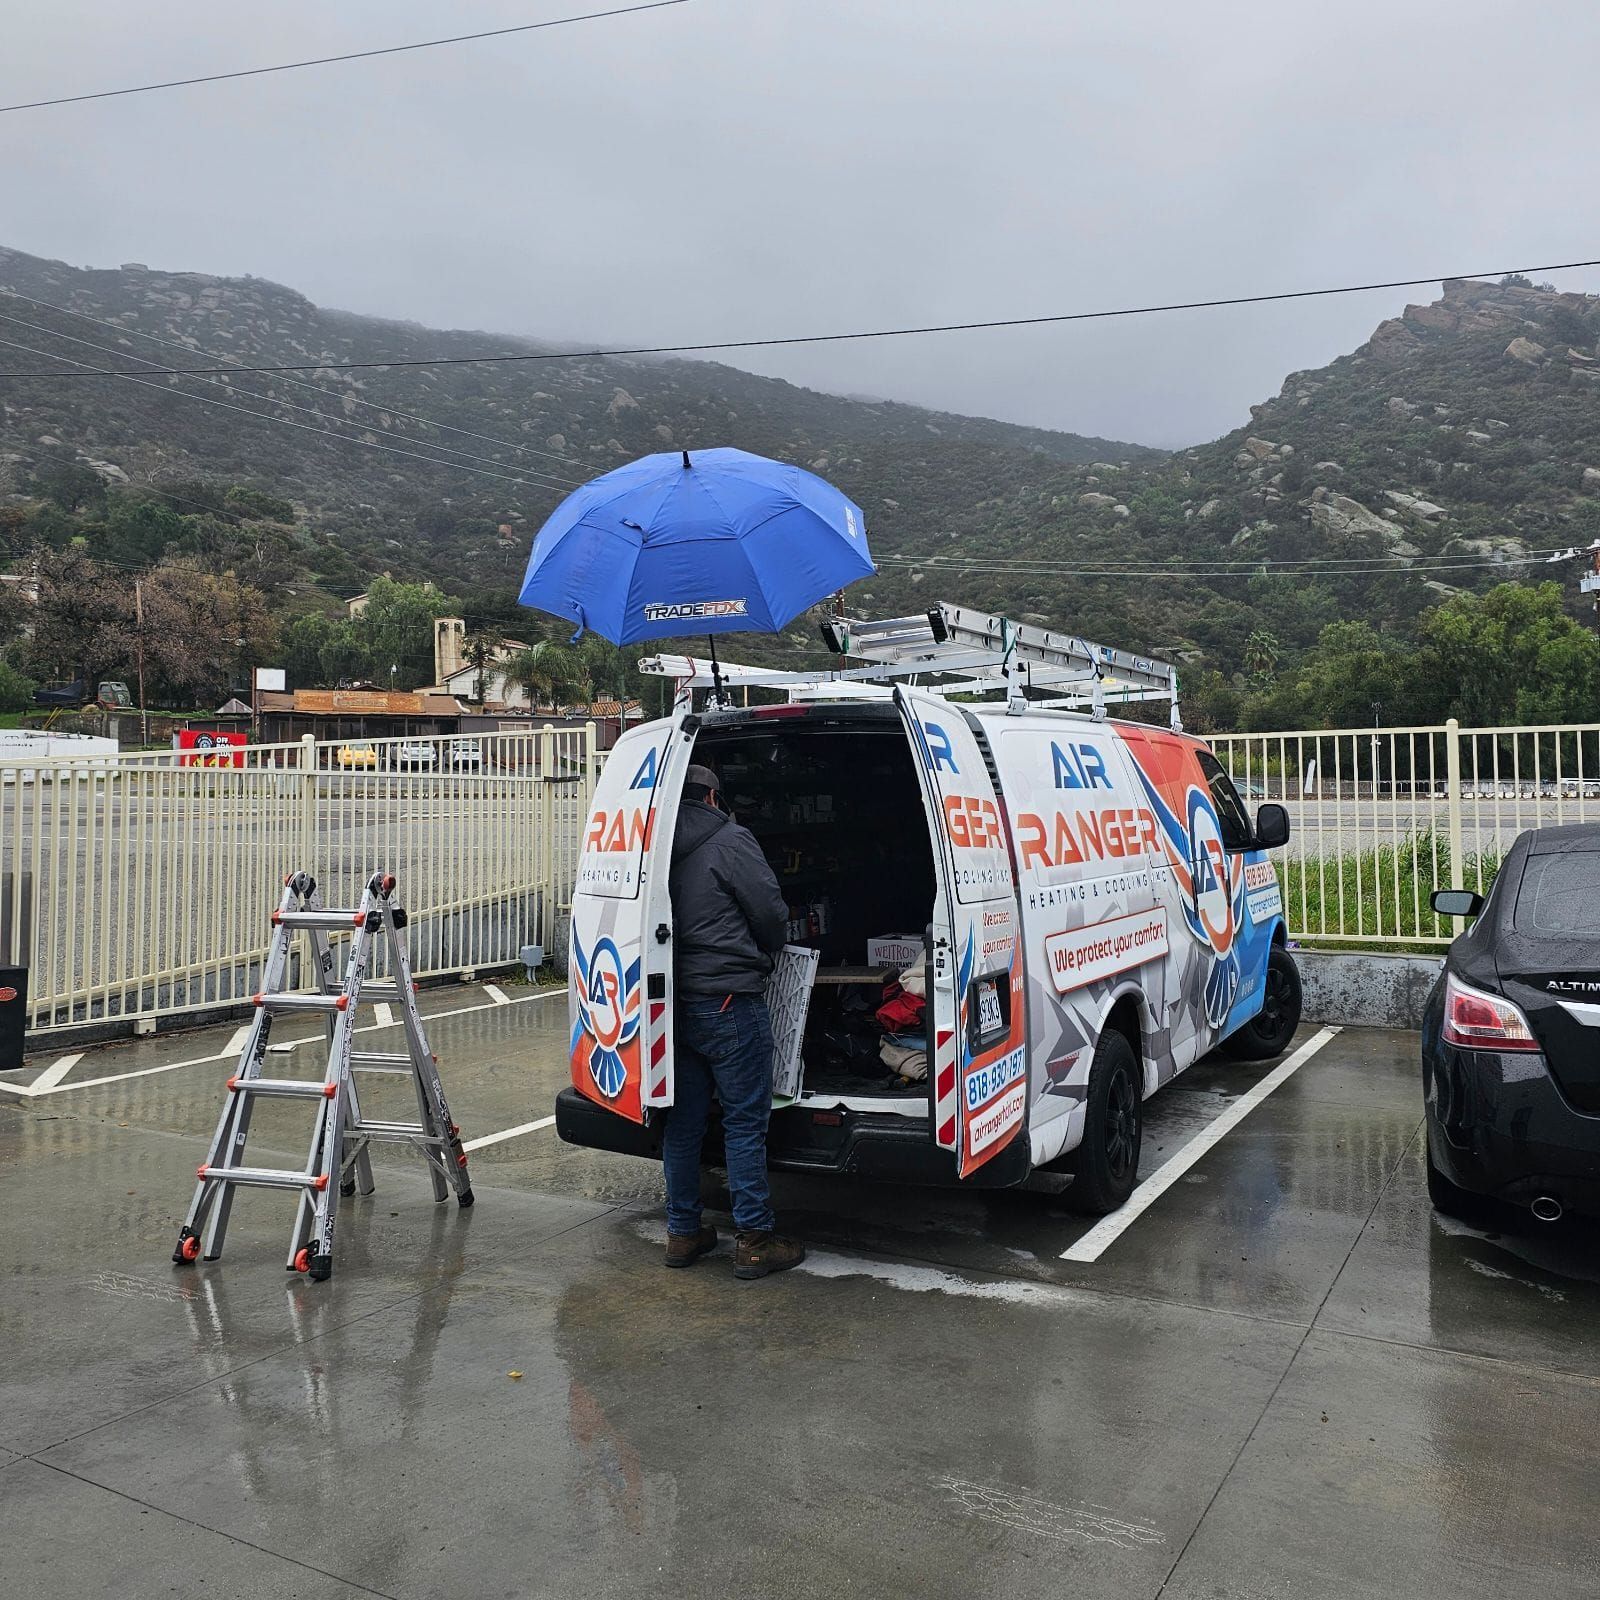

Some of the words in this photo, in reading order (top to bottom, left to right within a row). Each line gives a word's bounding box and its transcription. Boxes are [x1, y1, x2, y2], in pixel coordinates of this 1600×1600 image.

[1050, 740, 1114, 789] AIR
[587, 807, 656, 853] RAN
[1017, 808, 1161, 870] RANGER
[1029, 876, 1086, 910] HEATING
[1093, 883, 1099, 897] &
[1105, 872, 1148, 894] COOLING
[997, 934, 1015, 951] comfor
[1054, 948, 1075, 973] We
[1076, 936, 1113, 971] protect
[1113, 933, 1133, 959] your
[1134, 921, 1164, 947] comfort
